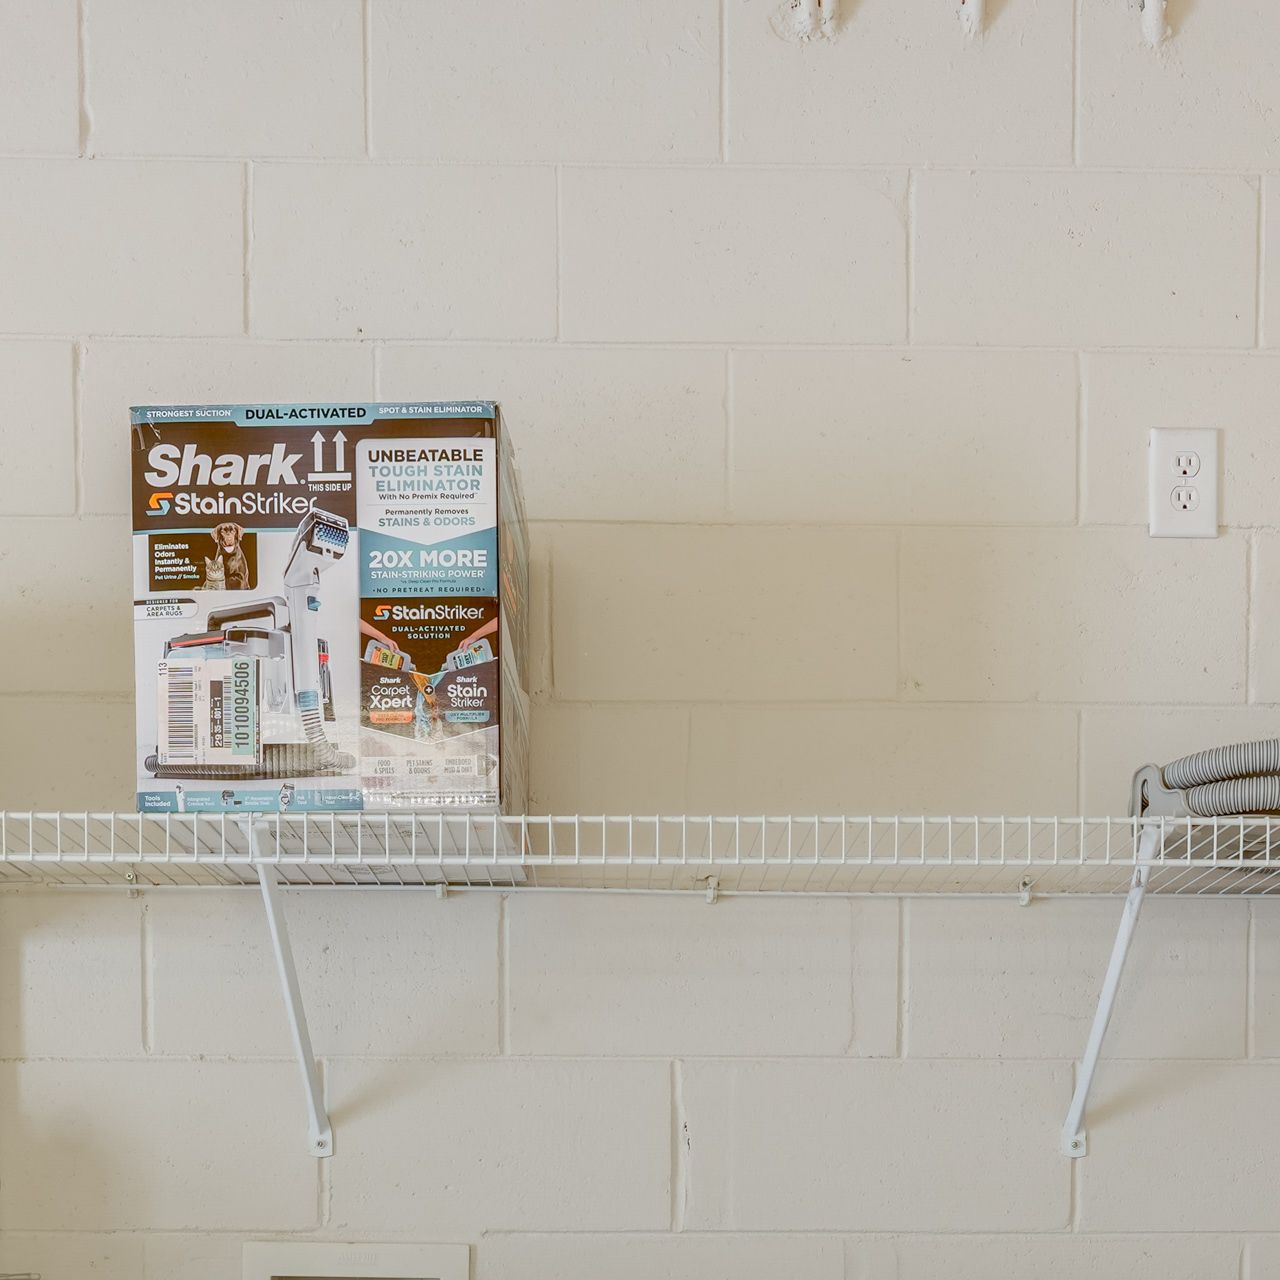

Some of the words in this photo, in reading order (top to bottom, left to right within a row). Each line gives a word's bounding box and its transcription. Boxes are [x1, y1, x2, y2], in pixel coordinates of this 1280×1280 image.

[146, 410, 194, 418] STRONGEST
[245, 407, 366, 420] DUAL-ACTIVATED
[368, 449, 483, 463] UNBEATABLE
[369, 466, 427, 477] TOUGH
[434, 465, 483, 476] STAIN
[308, 484, 323, 492] THIS
[376, 479, 481, 492] ELIMINATOR
[174, 491, 317, 515] StainStriker
[379, 518, 420, 527] STAINS
[423, 518, 431, 526] &
[434, 517, 475, 526] ODORS
[154, 558, 183, 566] Instantly
[369, 551, 413, 568] 20X
[420, 550, 487, 568] MORE
[154, 565, 197, 573] Permanently
[371, 571, 445, 579] STAIN-STRIKING
[448, 570, 484, 578] POWER
[392, 605, 484, 620] StainStriker
[159, 662, 167, 676] 113
[371, 685, 410, 696] Carpet
[447, 685, 488, 697] Stain
[234, 662, 249, 749] 1010094506
[370, 695, 413, 710] Xpert
[451, 698, 484, 707] Striker
